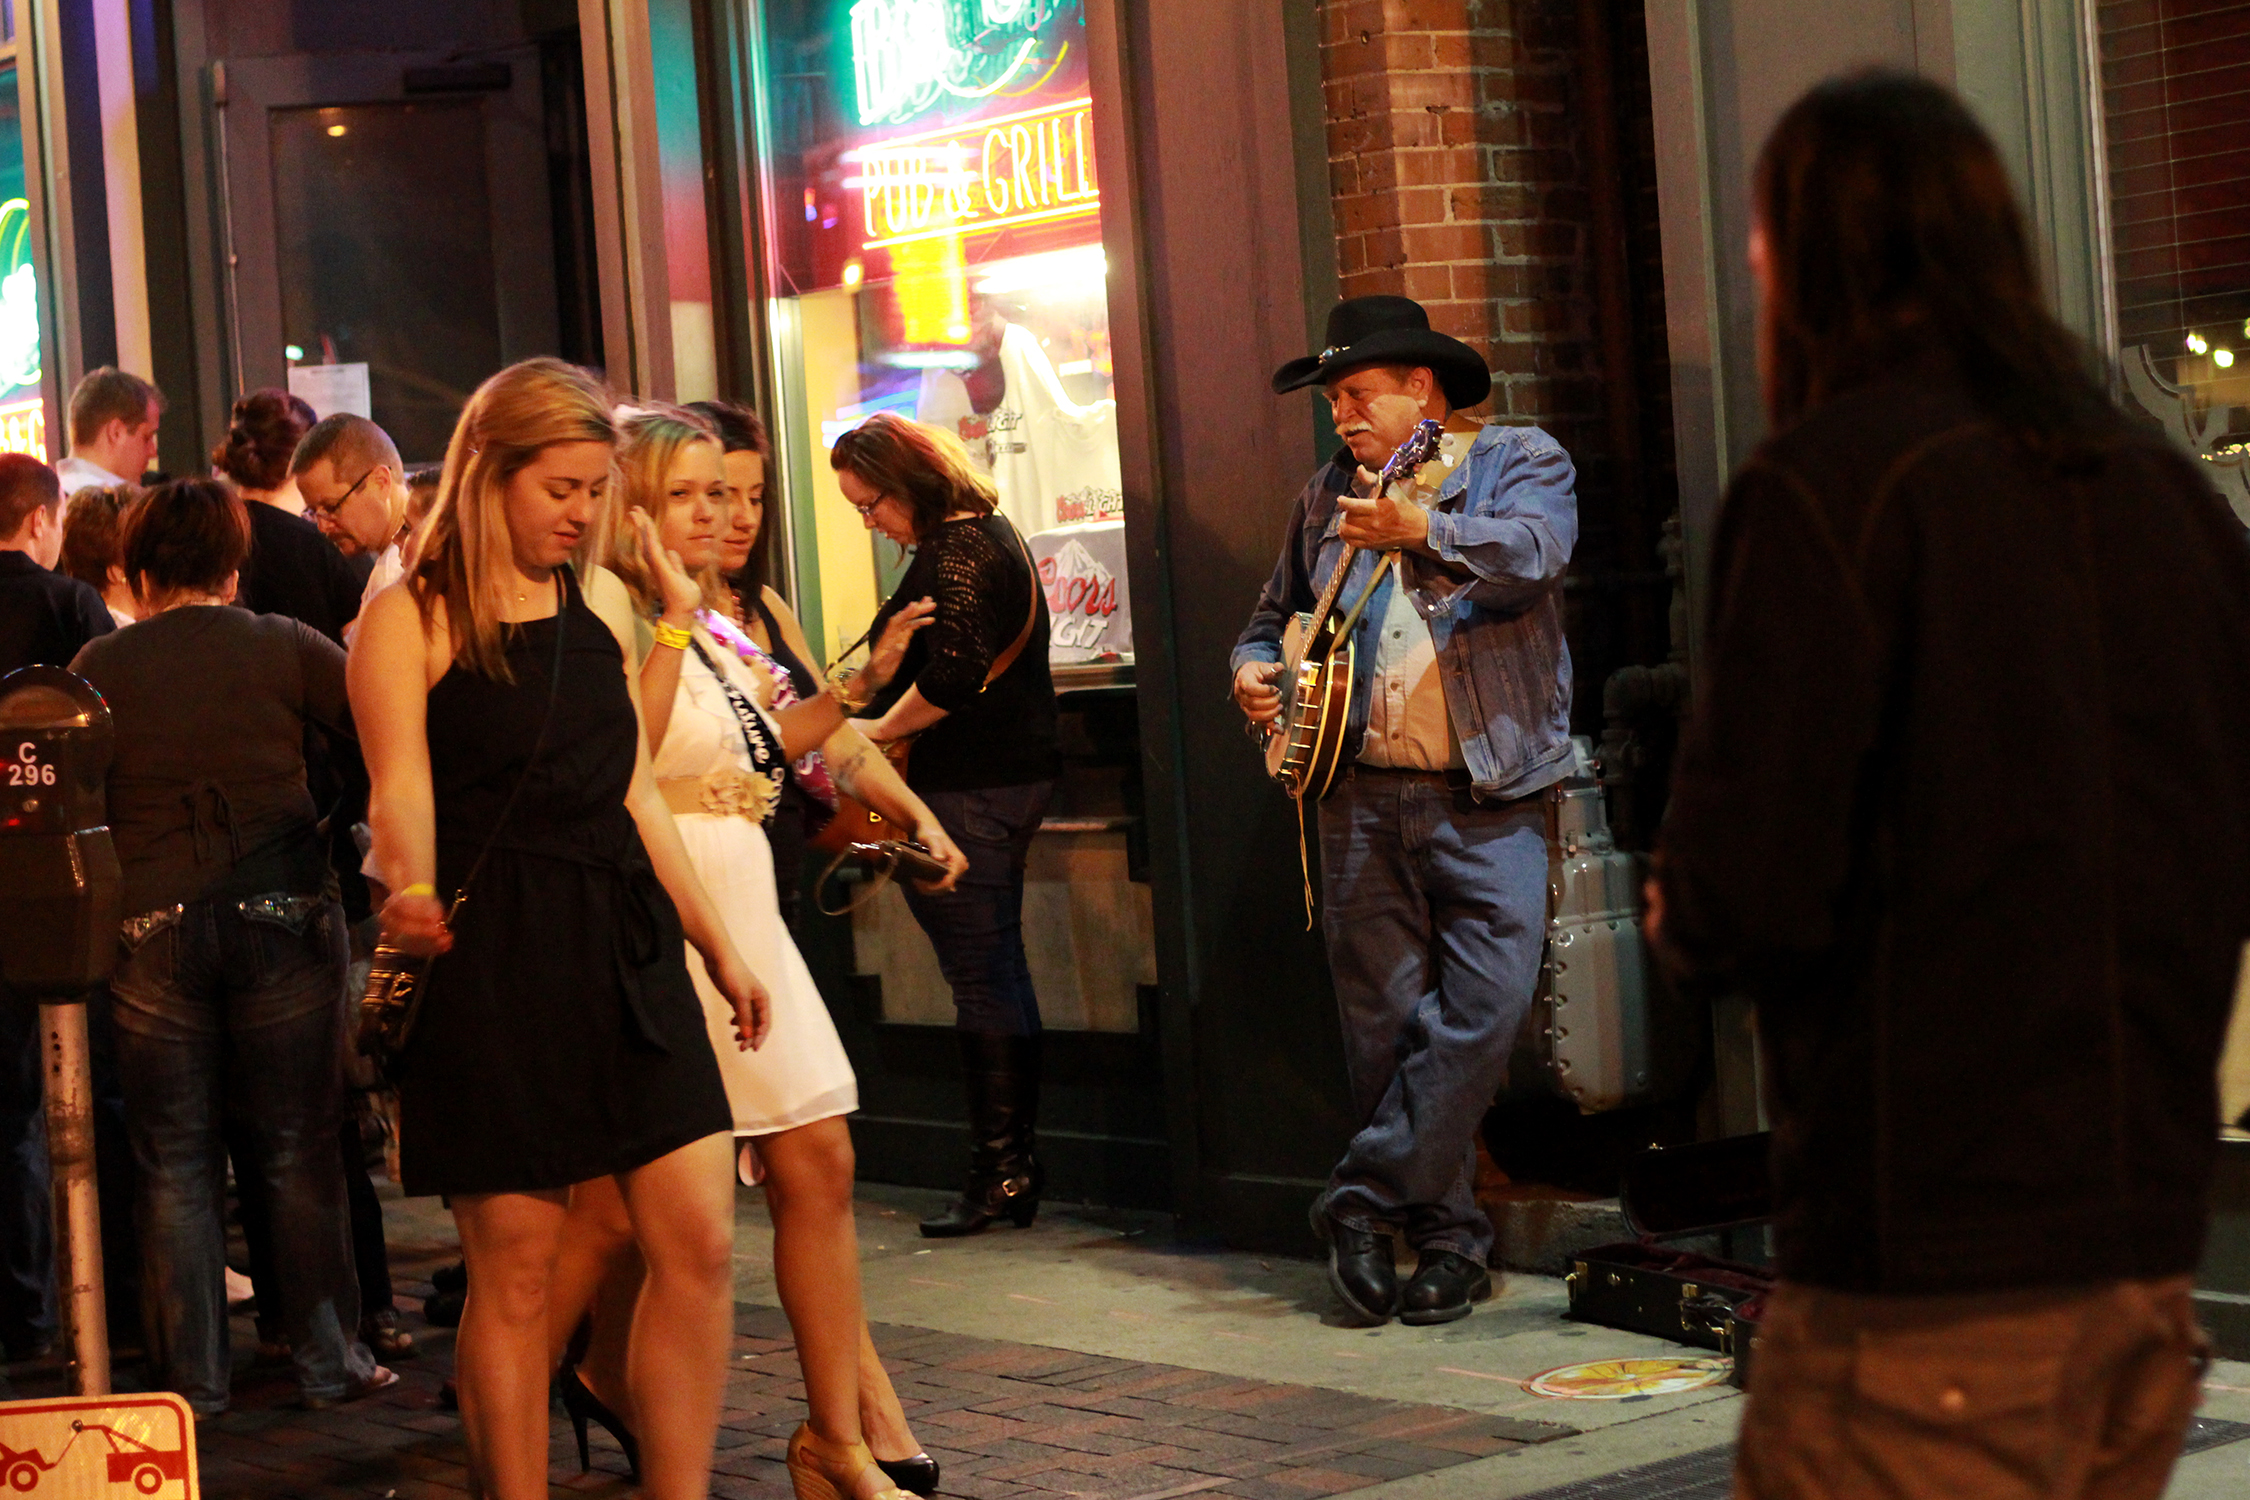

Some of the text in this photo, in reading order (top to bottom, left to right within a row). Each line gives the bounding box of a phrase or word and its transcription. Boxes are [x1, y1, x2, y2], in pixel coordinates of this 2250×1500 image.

[861, 149, 935, 237] PUB
[982, 112, 1101, 214] GRILL
[18, 741, 37, 764] C
[8, 763, 56, 786] 296
